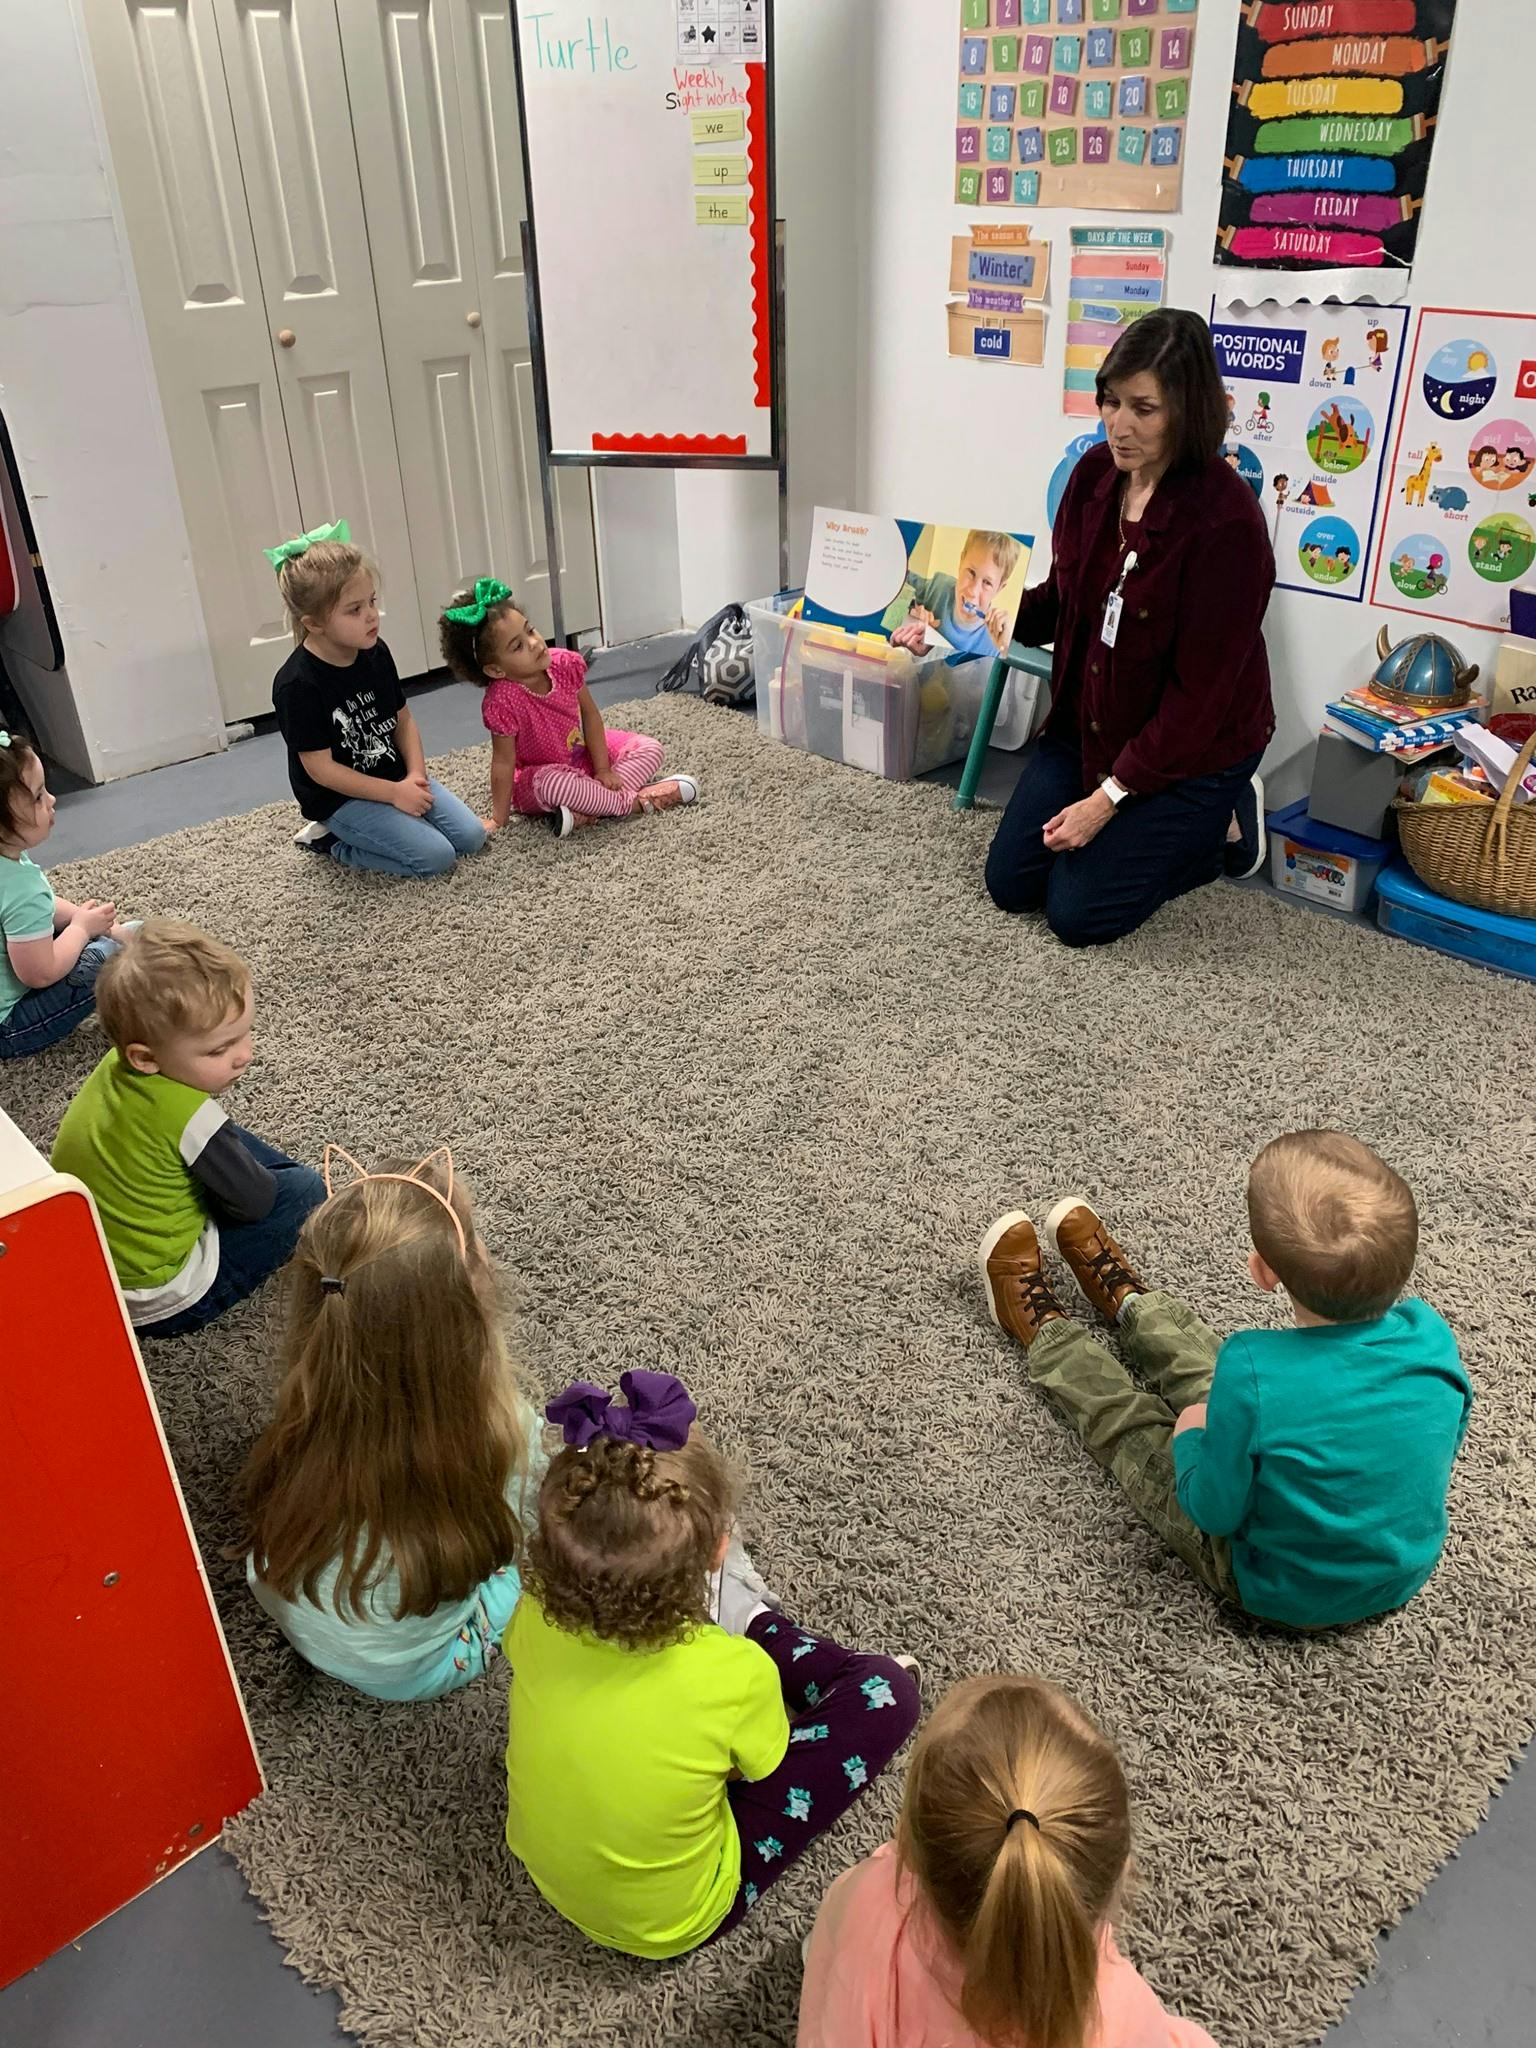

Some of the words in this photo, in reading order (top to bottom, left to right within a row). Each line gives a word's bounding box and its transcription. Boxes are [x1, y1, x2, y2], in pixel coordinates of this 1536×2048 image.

[1004, 0, 1012, 18] 2
[1032, 0, 1040, 15] 3
[1065, 0, 1074, 14] 4
[1283, 5, 1334, 30] SUNDAY
[524, 13, 637, 73] Turtle
[970, 47, 977, 65] 8
[1001, 45, 1008, 63] 9
[1031, 45, 1042, 64] 10
[1062, 46, 1072, 63] 11
[1093, 38, 1106, 57] 12
[1128, 38, 1142, 58] 13
[1167, 39, 1180, 59] 14
[1331, 42, 1387, 66] MONDAY
[673, 67, 725, 91] Weekly
[665, 88, 702, 115] Sight
[706, 87, 745, 106] words
[966, 92, 977, 109] 15
[997, 95, 1007, 112] 16
[1027, 89, 1037, 107] 17
[1057, 86, 1068, 104] 18
[1092, 90, 1104, 109] 19
[1126, 87, 1139, 106] 20
[1165, 89, 1178, 109] 21
[1286, 83, 1338, 106] TUESDAY
[705, 122, 724, 135] we
[1319, 122, 1392, 143] WEDNESDAY
[961, 137, 974, 154] 22
[993, 135, 1004, 152] 23
[1024, 137, 1037, 155] 24
[1056, 137, 1069, 155] 25
[1088, 136, 1102, 154] 26
[1125, 136, 1139, 154] 27
[1158, 137, 1172, 156] 28
[713, 166, 729, 184] up
[1287, 159, 1344, 179] THURSDAY
[961, 177, 973, 193] 29
[992, 176, 1004, 193] 30
[1021, 179, 1032, 195] 31
[708, 203, 729, 219] the
[1314, 196, 1358, 217] FRIDAY
[976, 230, 989, 241] The
[991, 230, 1014, 240] season
[1016, 230, 1023, 240] is
[1087, 231, 1105, 242] DAYS
[1106, 231, 1116, 242] OF
[1118, 231, 1132, 243] THE
[1133, 231, 1153, 243] WEEK
[1273, 231, 1331, 254] SATURDAY
[979, 254, 1024, 280] Winter
[1125, 261, 1150, 273] Sunday
[1124, 285, 1150, 297] Monday
[971, 292, 983, 304] The
[985, 295, 1012, 307] weather
[1013, 296, 1020, 308] is
[1367, 318, 1379, 328] up
[980, 334, 1003, 350] cold
[1213, 333, 1302, 355] POSITIONAL
[1225, 350, 1286, 371] WORDS
[1309, 377, 1332, 389] down
[1459, 393, 1486, 406] night
[1253, 431, 1272, 442] after
[1408, 450, 1423, 459] tall
[1323, 458, 1348, 471] below
[1312, 474, 1337, 484] inside
[1285, 506, 1316, 516] outside
[1444, 510, 1469, 521] short
[825, 521, 841, 533] Why
[842, 524, 869, 535] Brush?
[1316, 531, 1336, 541] over
[1474, 561, 1502, 572] stand
[1313, 572, 1338, 582] under
[1396, 579, 1417, 591] slow
